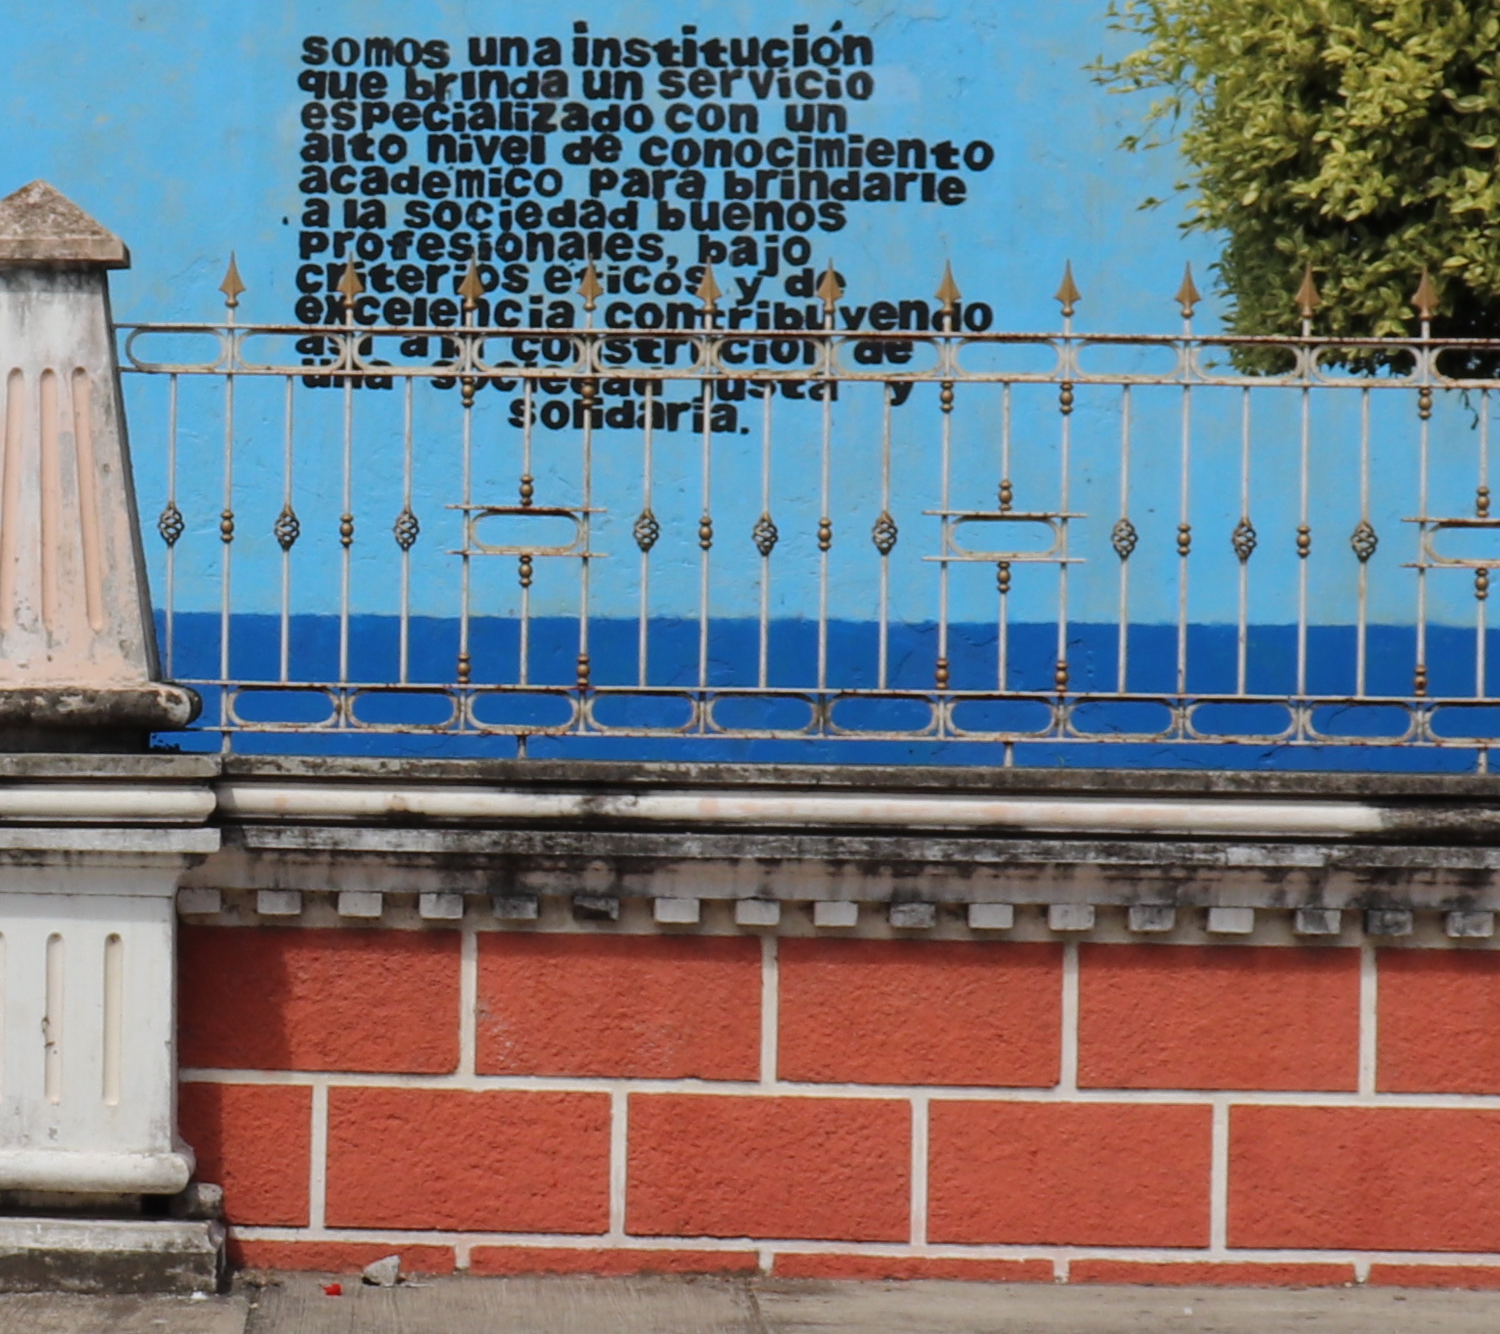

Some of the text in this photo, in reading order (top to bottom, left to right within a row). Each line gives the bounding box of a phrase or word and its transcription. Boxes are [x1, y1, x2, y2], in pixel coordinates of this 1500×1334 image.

[301, 19, 874, 69] somos una institución
[298, 66, 875, 102] que brinda un servicio
[300, 101, 848, 134] especializado con un
[299, 131, 995, 172] alto nivel de conocimiento
[589, 167, 706, 202] para
[724, 169, 968, 206] brindarle
[301, 198, 848, 232] a la sociedad buenos
[697, 233, 812, 277] bajo
[543, 261, 710, 297] éicos
[735, 275, 764, 306] y
[295, 293, 993, 331] excelencia contribuyendo
[430, 359, 663, 395] sciead
